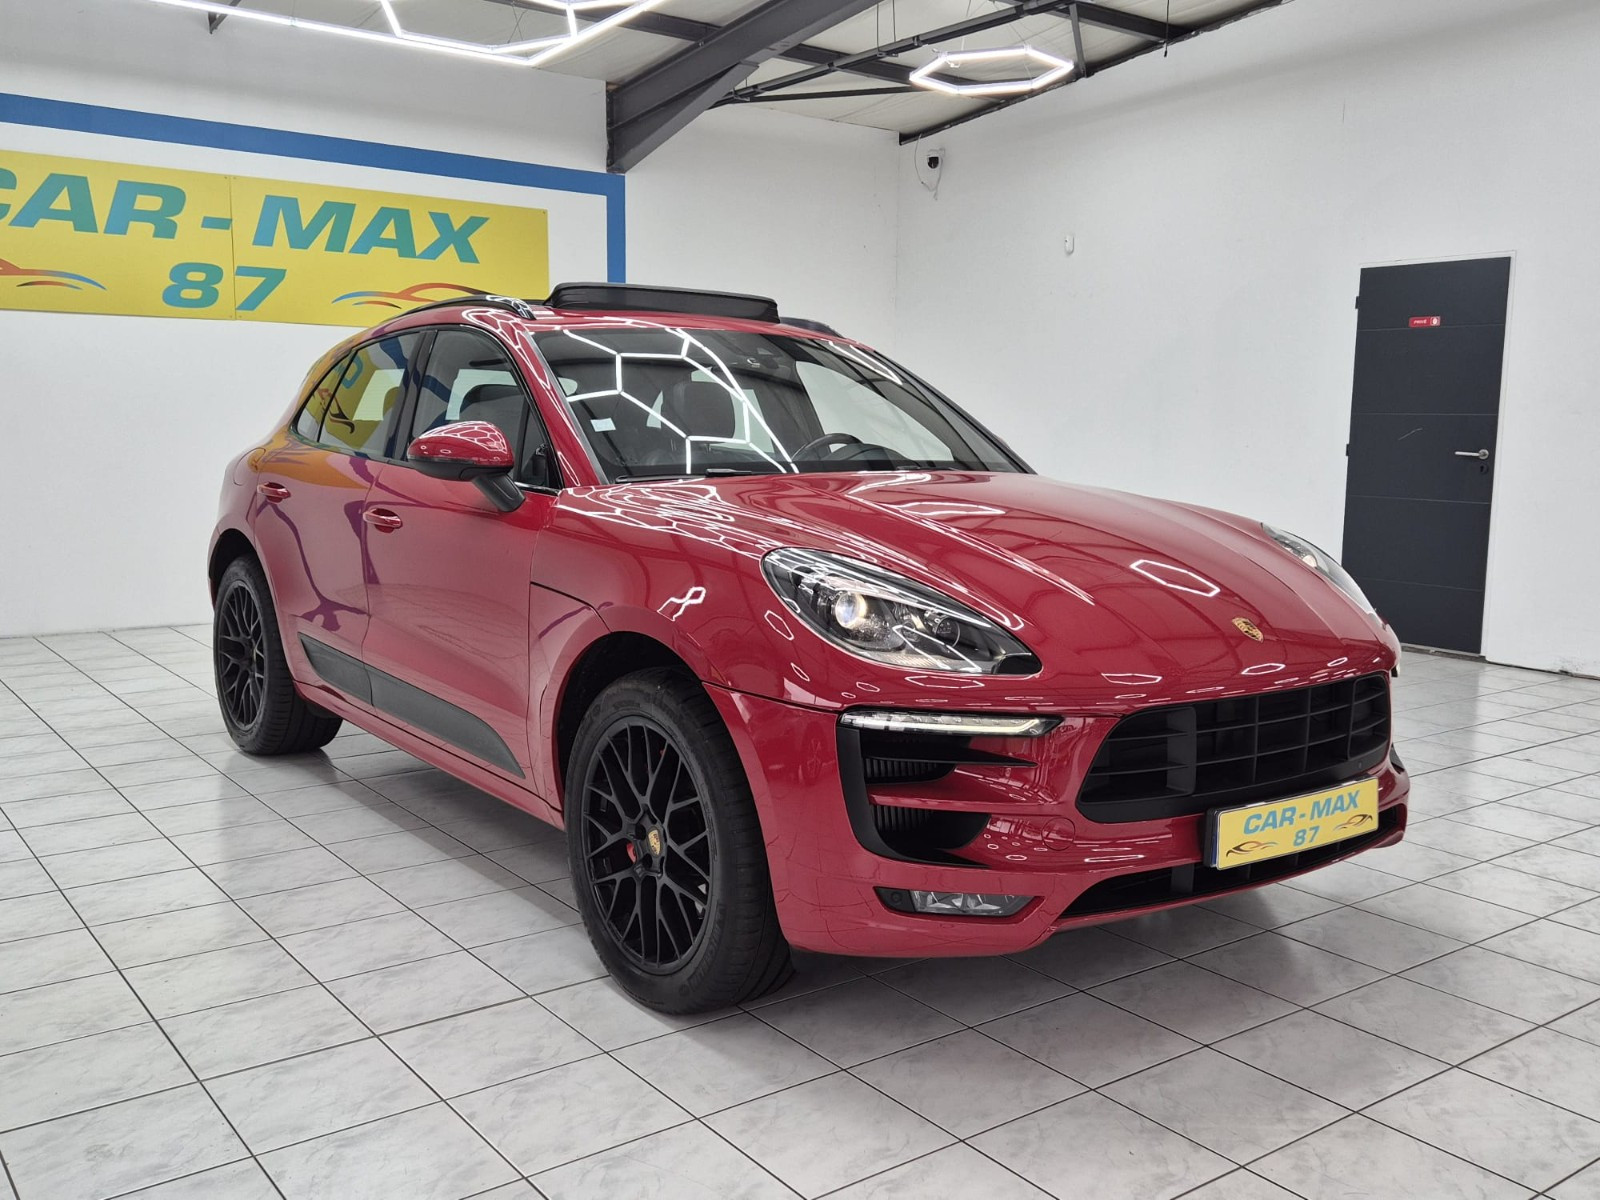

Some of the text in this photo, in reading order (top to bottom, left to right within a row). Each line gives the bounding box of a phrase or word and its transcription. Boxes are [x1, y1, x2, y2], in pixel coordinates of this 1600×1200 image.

[0, 168, 187, 240] AR
[162, 262, 287, 312] 87
[1293, 825, 1321, 847] 87
